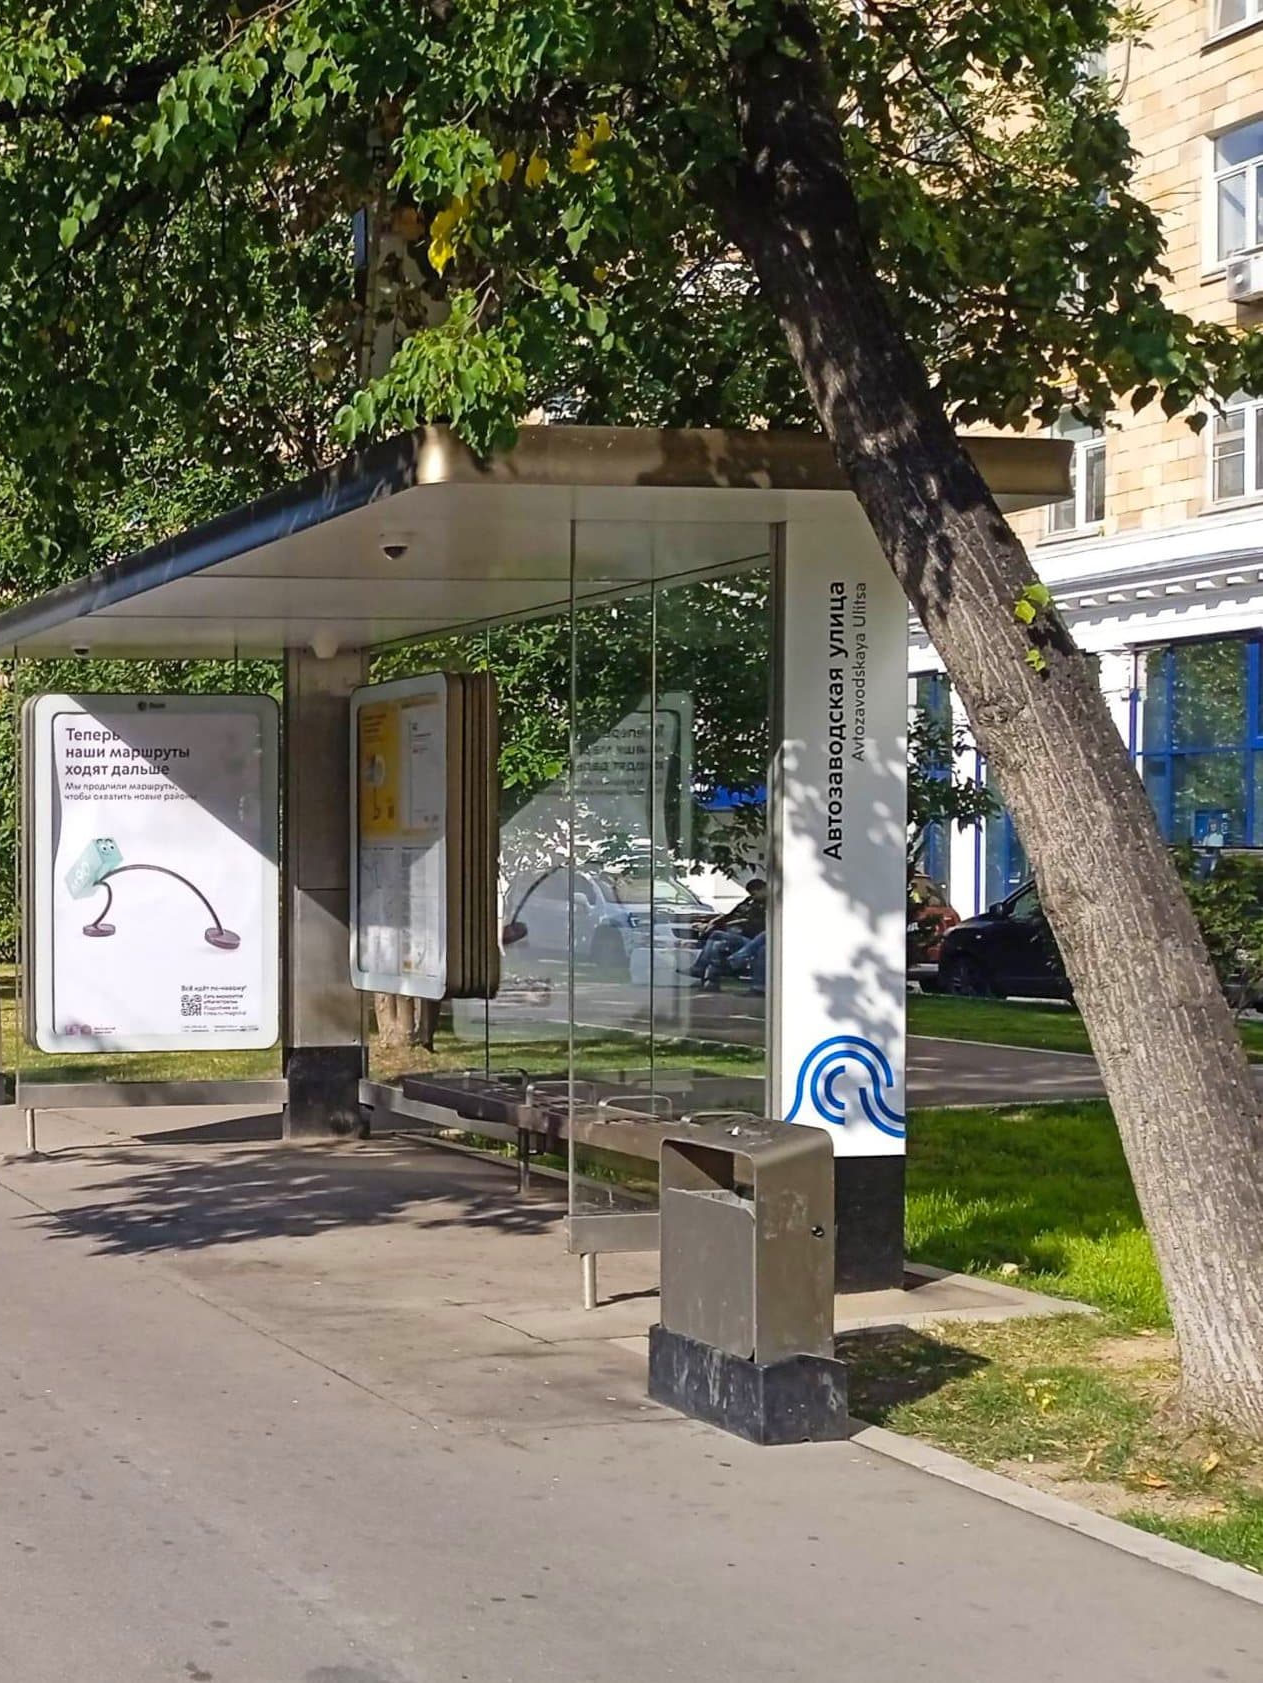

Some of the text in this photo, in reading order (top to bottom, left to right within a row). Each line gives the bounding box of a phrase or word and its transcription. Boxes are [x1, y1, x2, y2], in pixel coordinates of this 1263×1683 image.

[851, 582, 869, 762] Avtozavodskaya Ulitsa
[823, 581, 848, 861] Автозаводская улица
[65, 727, 122, 743] Теперь
[66, 748, 190, 761] наши маршруты
[65, 764, 170, 777] ходят дальше
[64, 782, 178, 793] Мы продлили маршруты,
[64, 791, 92, 801] чтобы
[93, 793, 132, 801] охватить
[134, 793, 162, 801] новые
